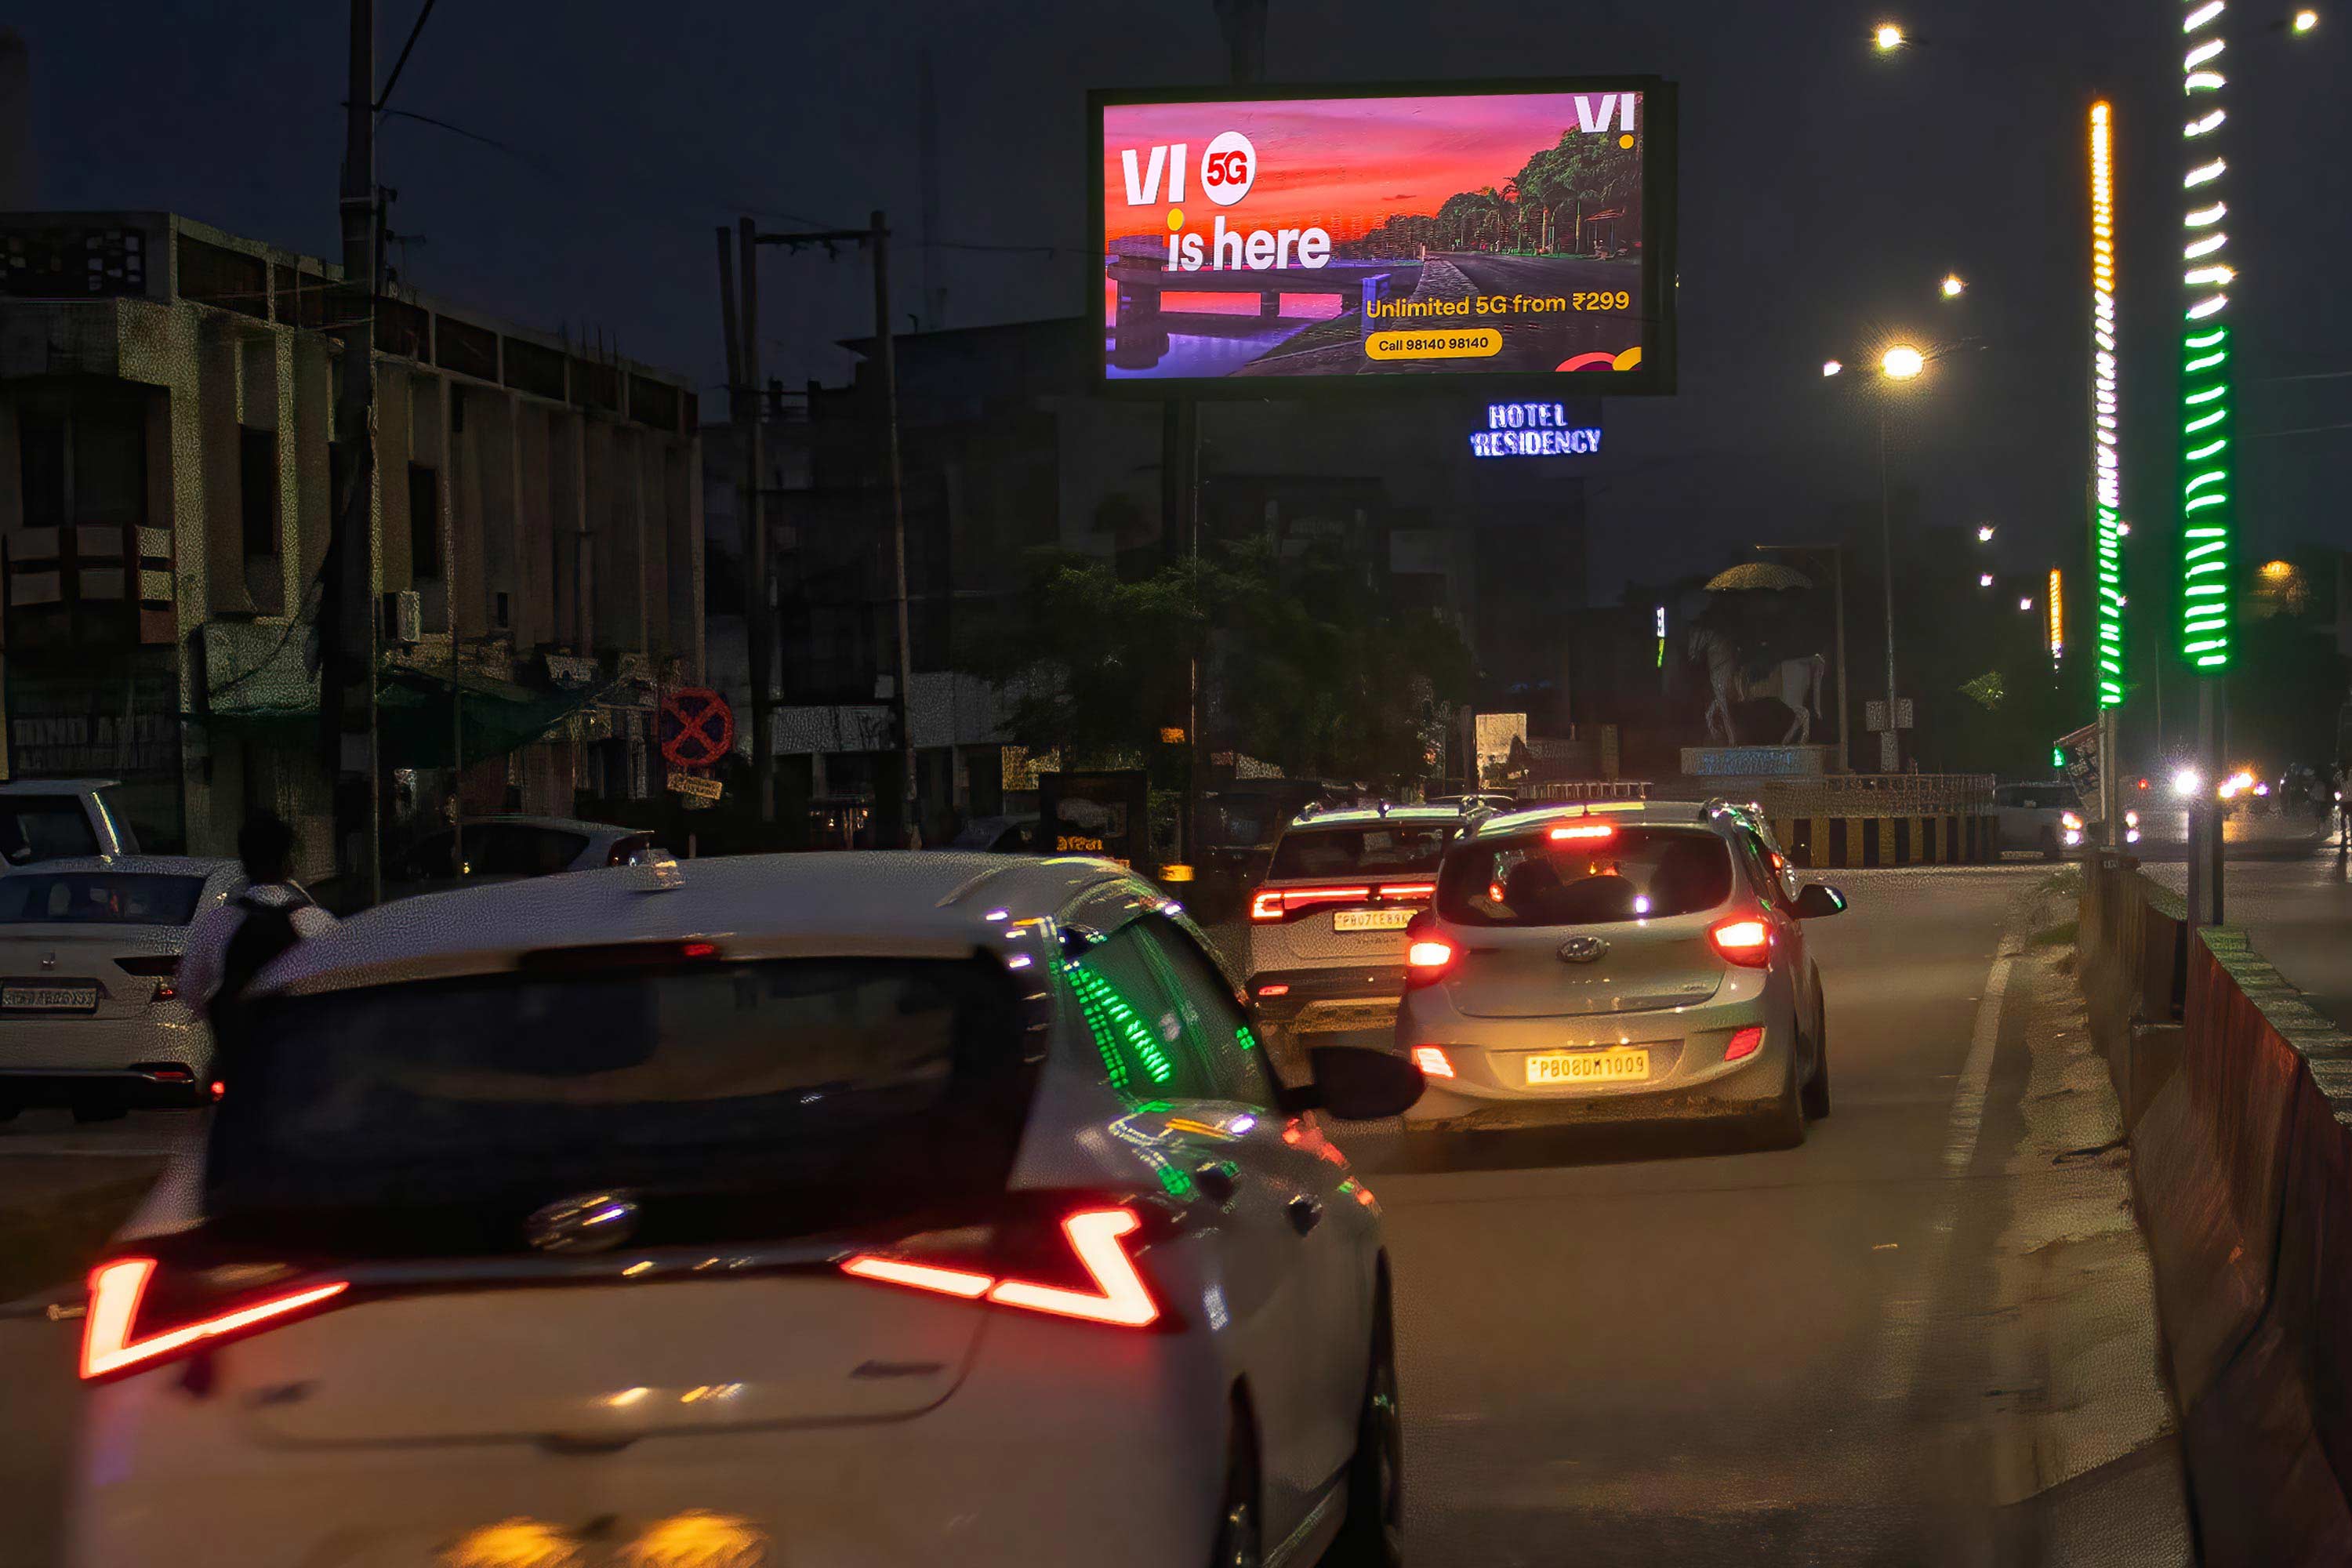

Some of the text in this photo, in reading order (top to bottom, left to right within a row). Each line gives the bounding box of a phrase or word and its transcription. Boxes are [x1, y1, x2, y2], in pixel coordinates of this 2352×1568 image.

[1207, 151, 1247, 187] 5G
[1167, 208, 1330, 272] is here
[1367, 291, 1630, 318] Unlimited 5G from ₹299
[1379, 337, 1489, 351] Call 98140 98140
[1489, 403, 1568, 429] HOTEL
[1472, 429, 1602, 456] RESIDENCY
